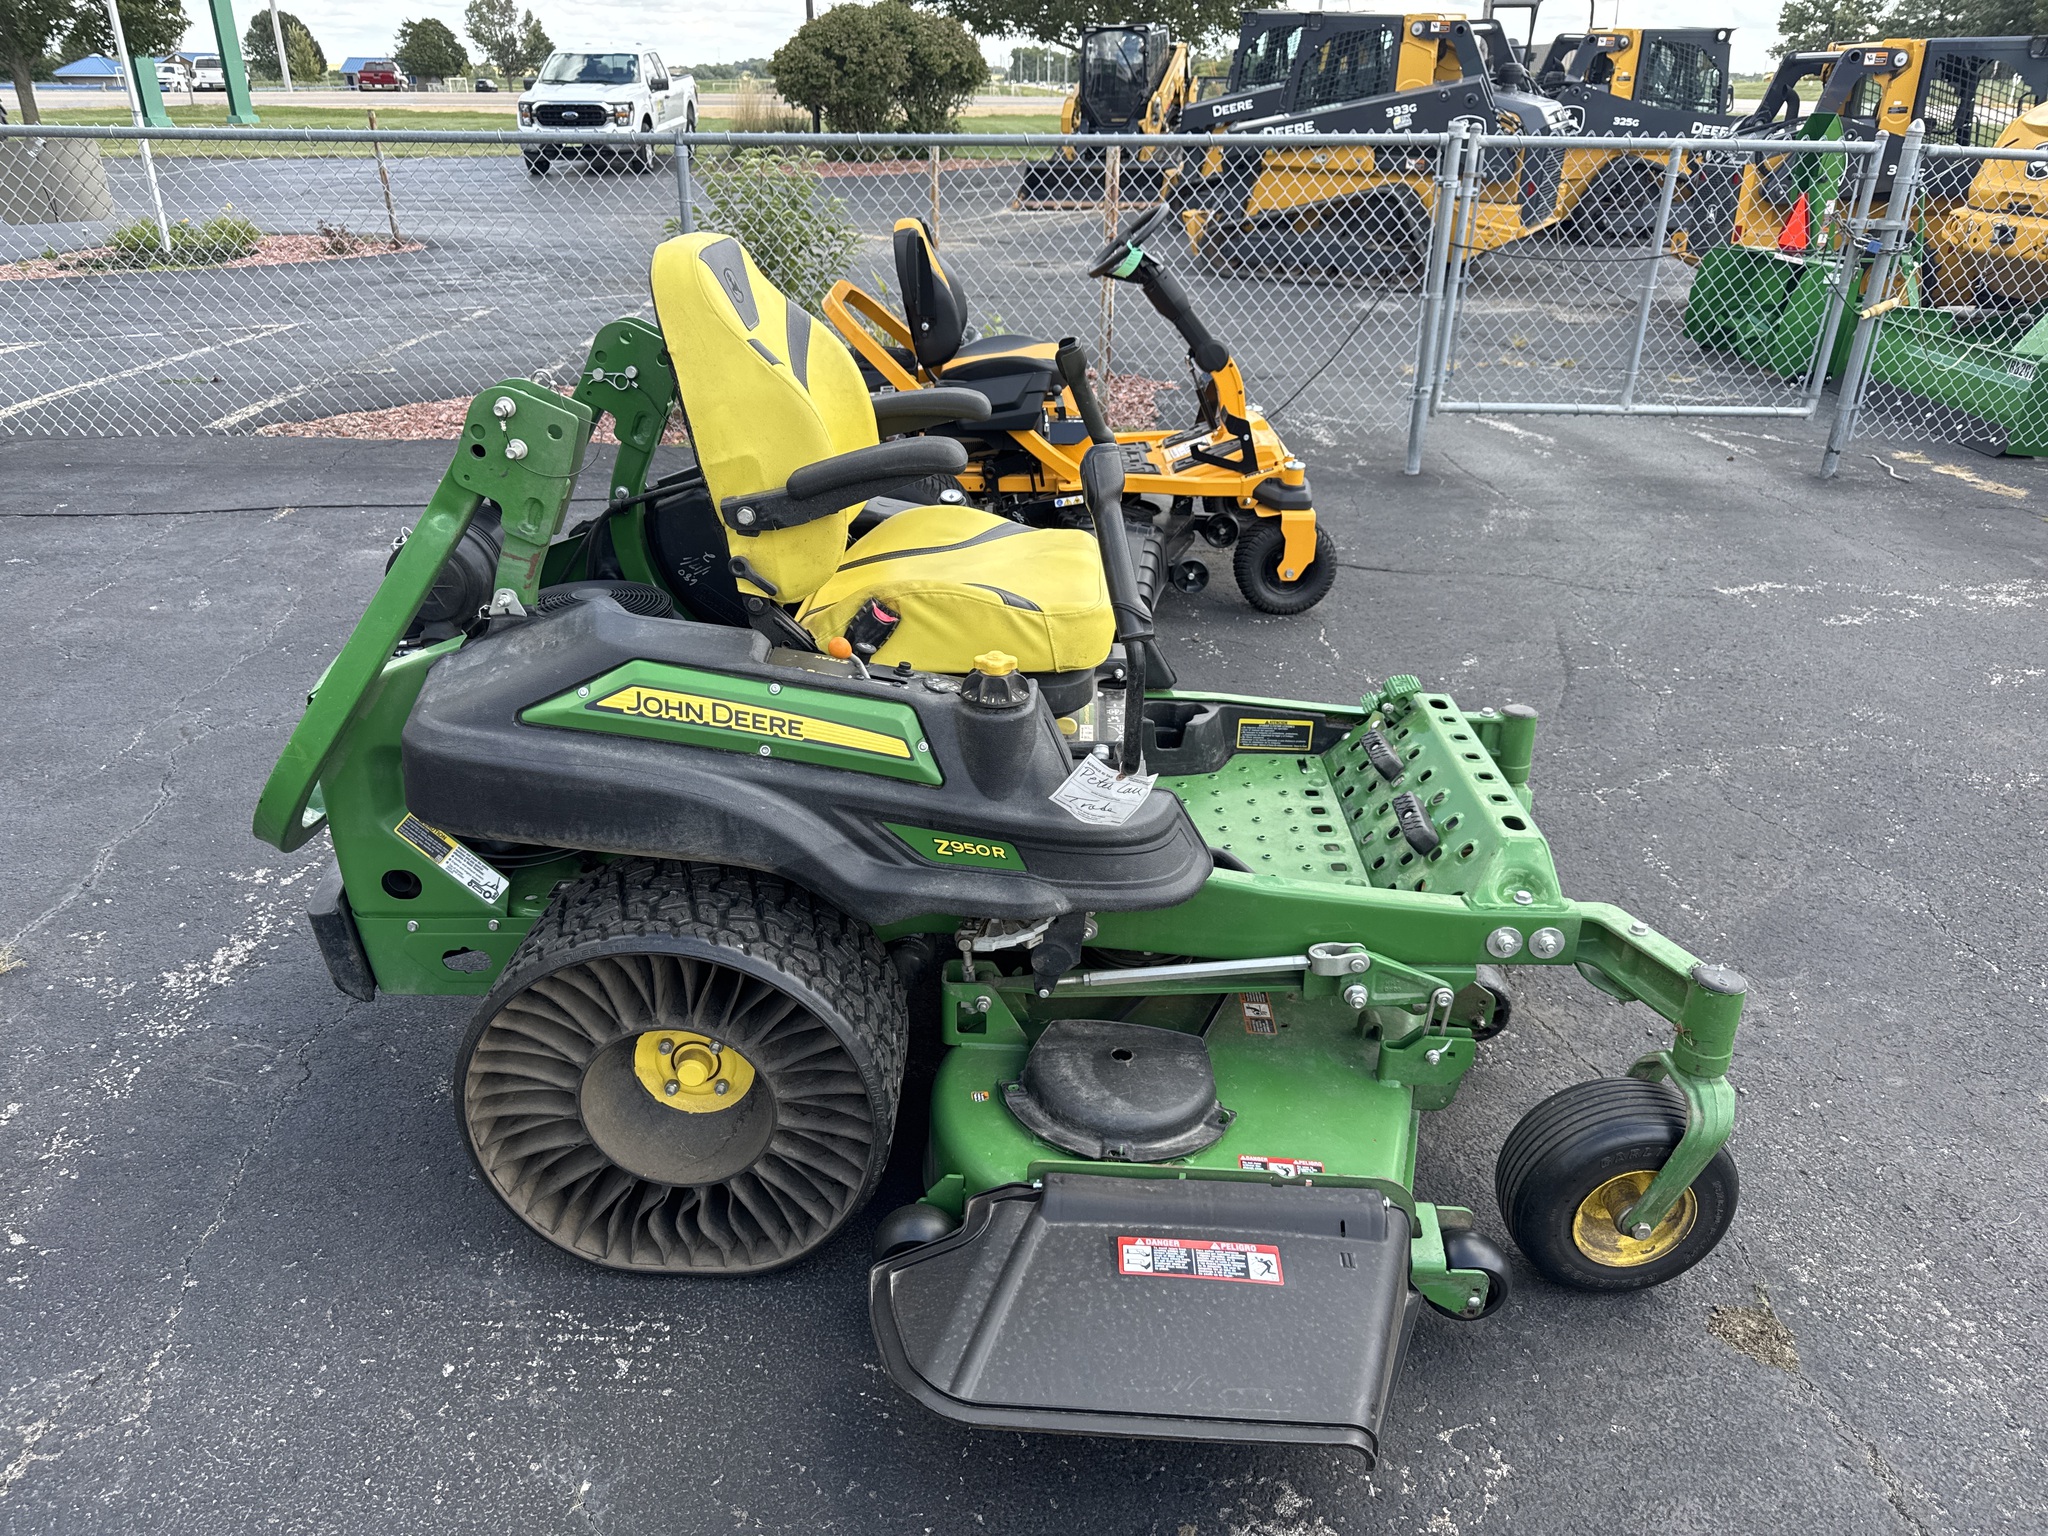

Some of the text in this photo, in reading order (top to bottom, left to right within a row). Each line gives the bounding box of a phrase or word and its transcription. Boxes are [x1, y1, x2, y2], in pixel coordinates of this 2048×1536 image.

[1212, 98, 1254, 118] DEERE
[1385, 103, 1418, 118] 333G
[1612, 116, 1640, 127] 325G
[626, 690, 804, 738] JOHN DEERE
[1145, 1239, 1257, 1252] DANGER PELIGRO
